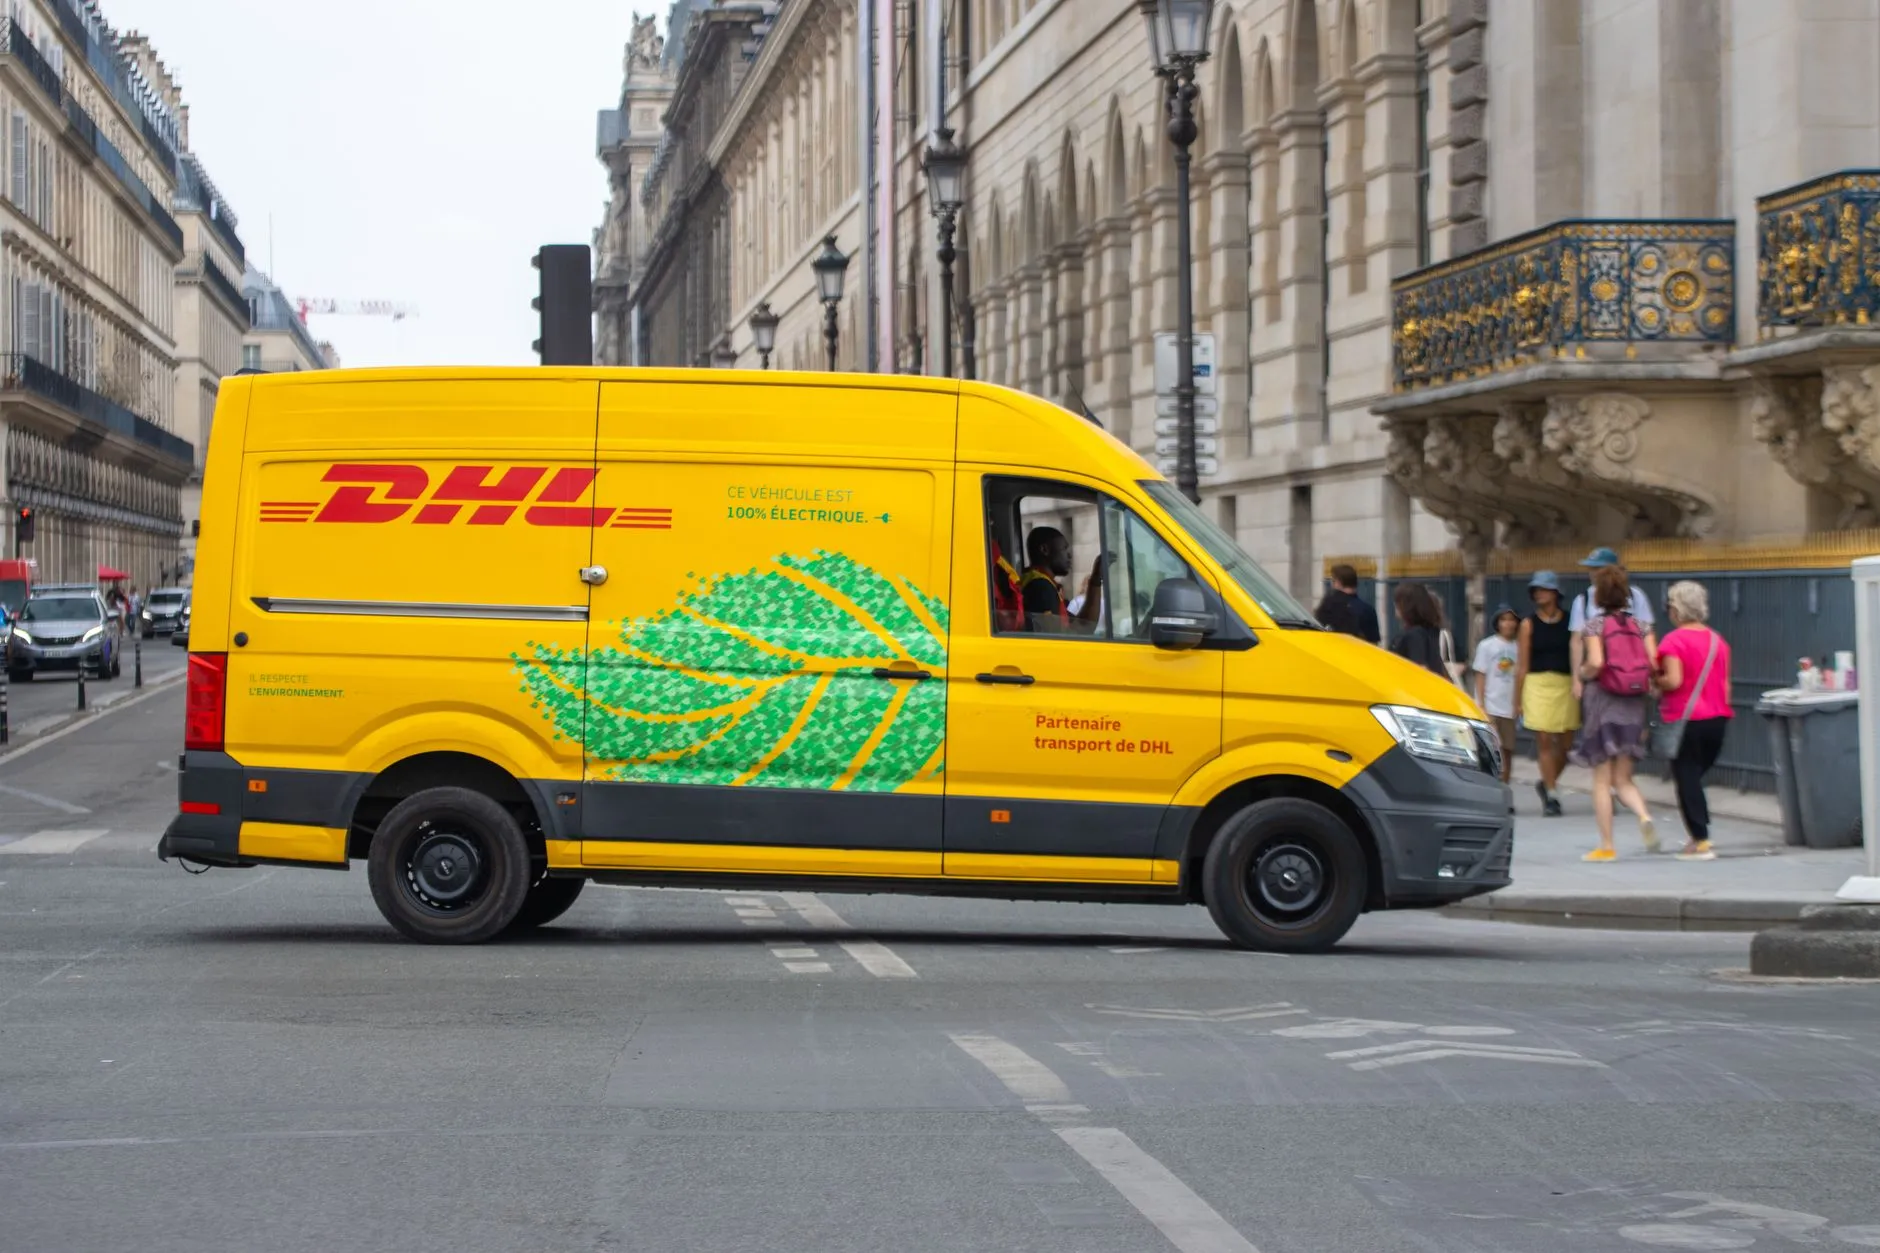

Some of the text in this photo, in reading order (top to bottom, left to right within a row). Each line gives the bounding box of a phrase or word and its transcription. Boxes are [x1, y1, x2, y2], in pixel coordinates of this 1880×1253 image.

[314, 464, 617, 527] DHL
[727, 485, 854, 502] CE VÉHICULE EST
[727, 505, 868, 524] 100% ÉLECTRIQUE.
[249, 673, 309, 684] IL RESPECTE
[1035, 715, 1121, 731] Partenaire
[1034, 736, 1174, 754] transport de DHL
